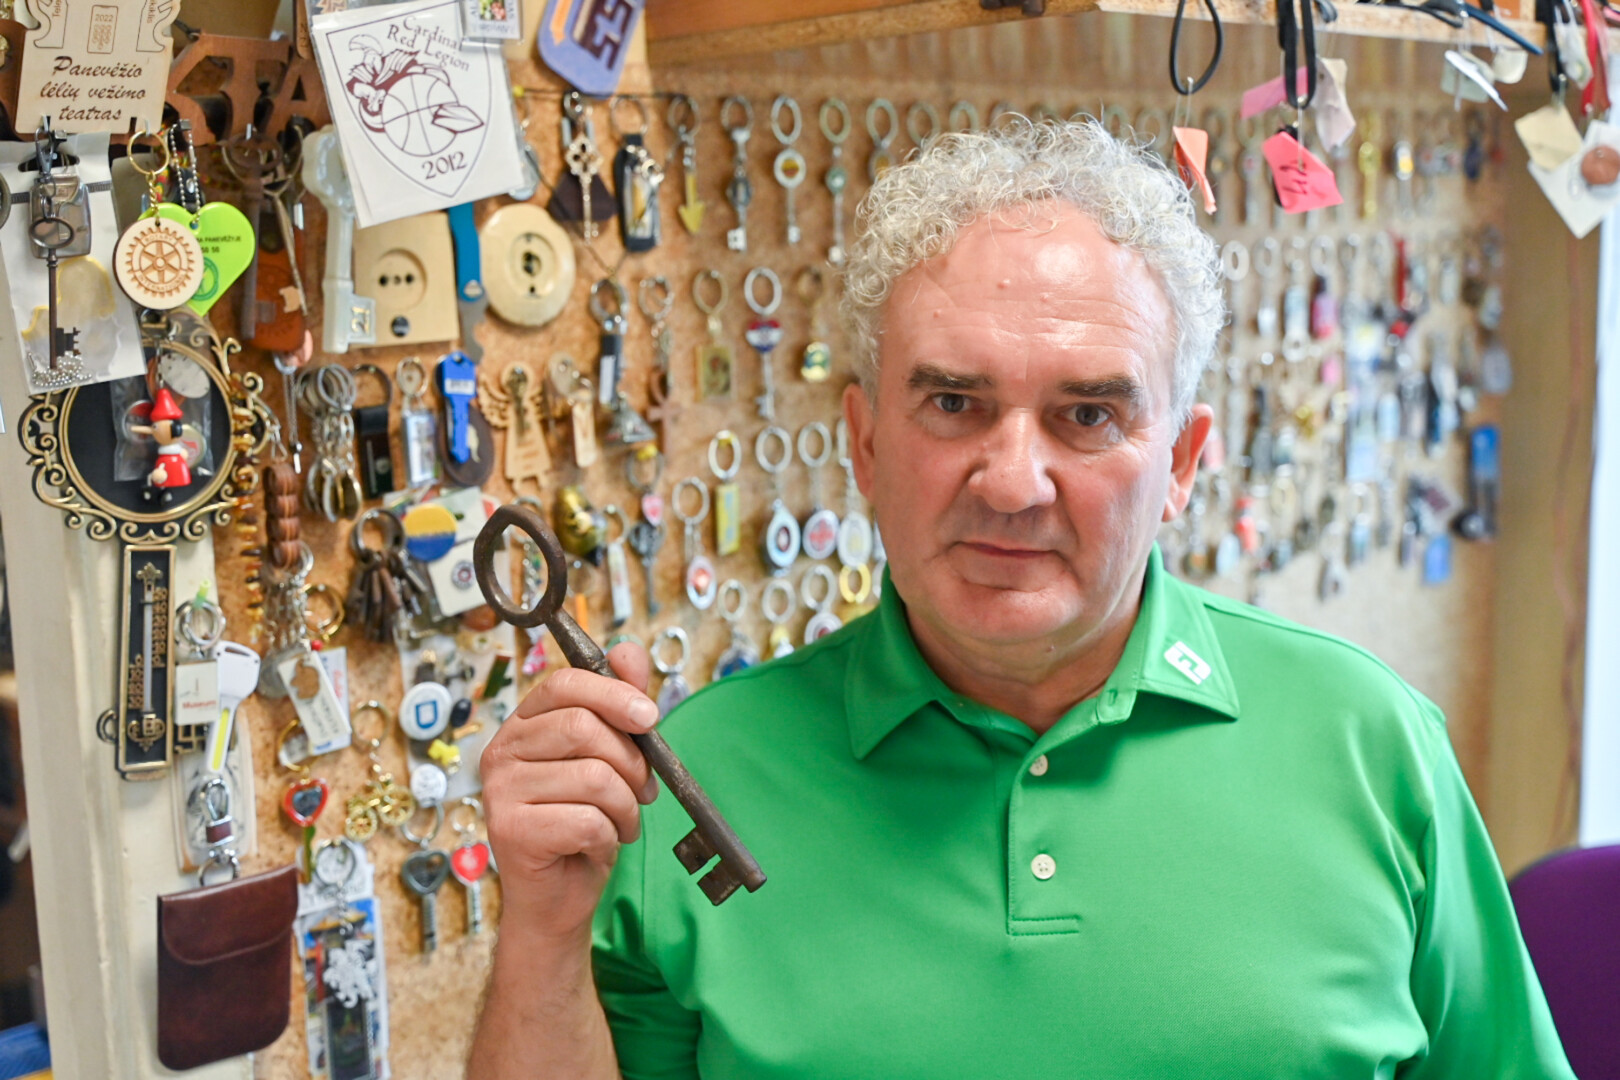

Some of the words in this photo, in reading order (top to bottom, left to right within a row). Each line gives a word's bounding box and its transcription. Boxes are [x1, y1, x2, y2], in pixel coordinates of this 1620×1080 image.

[95, 14, 113, 22] 2022
[403, 15, 462, 51] Cardinal
[387, 23, 417, 48] Red
[424, 35, 470, 72] Legion
[52, 56, 142, 78] Panevėžio
[88, 84, 147, 100] vežimo
[58, 105, 122, 120] teatras
[421, 151, 468, 180] 2012
